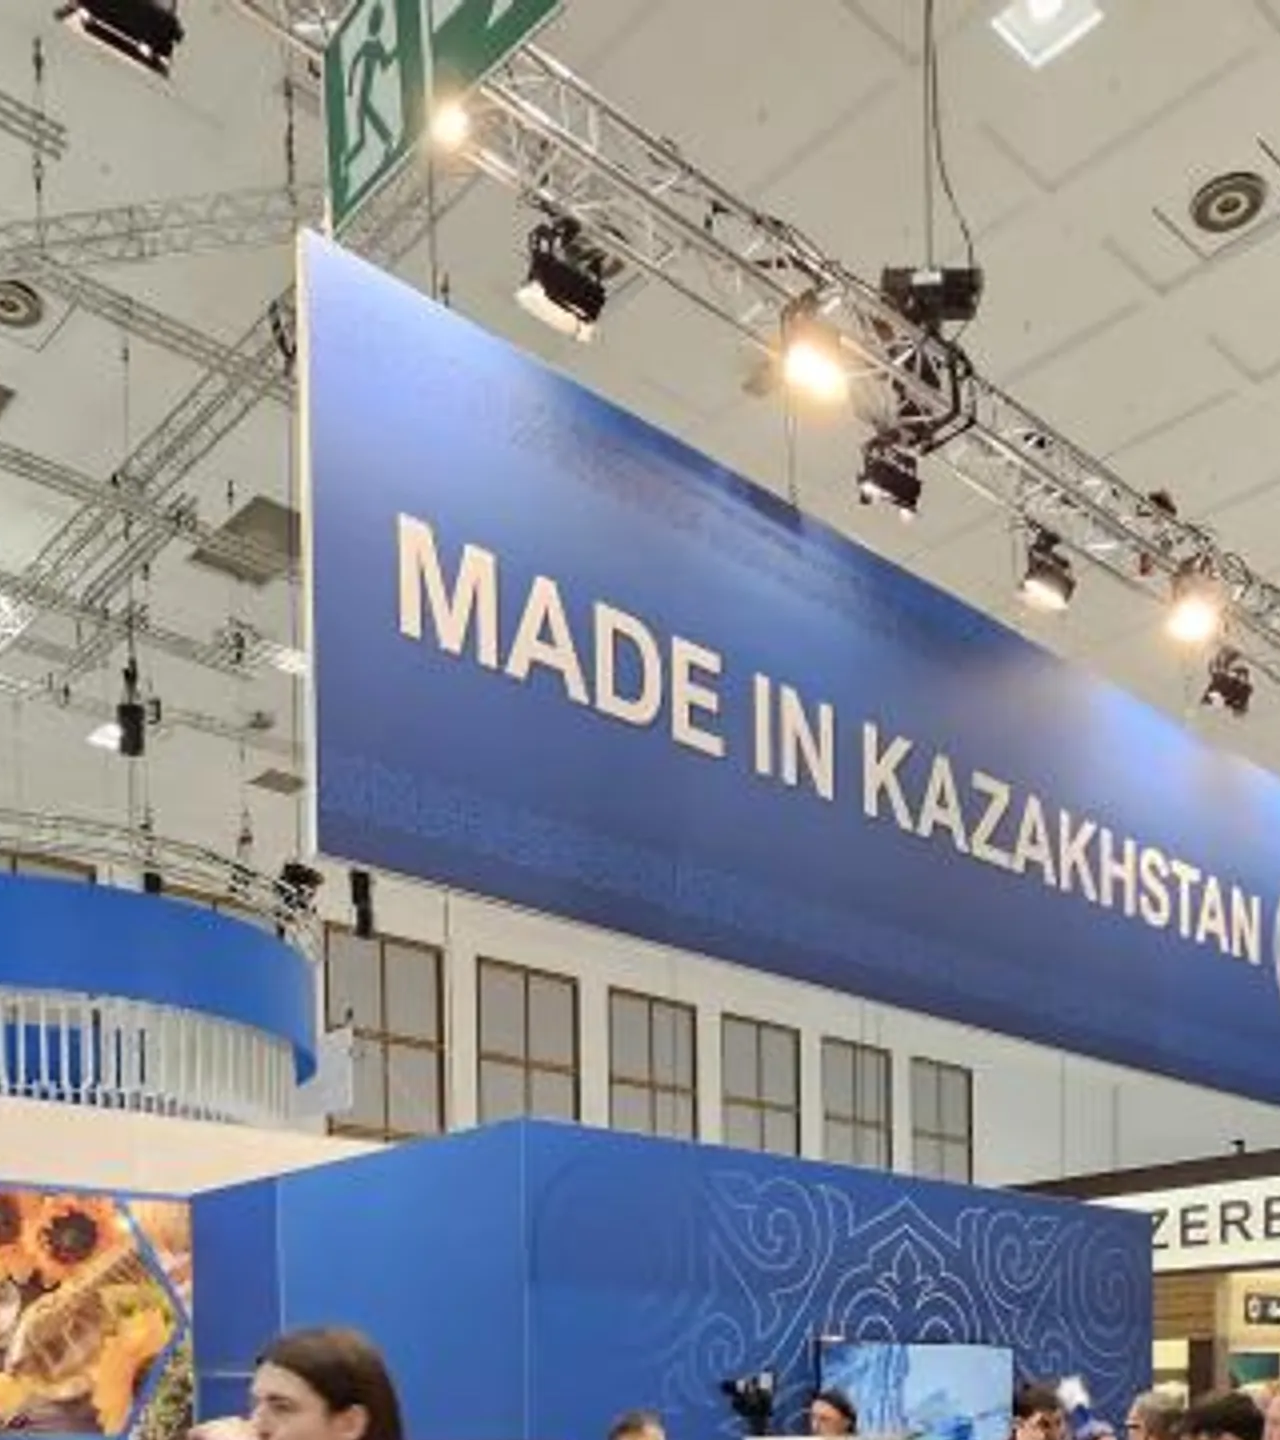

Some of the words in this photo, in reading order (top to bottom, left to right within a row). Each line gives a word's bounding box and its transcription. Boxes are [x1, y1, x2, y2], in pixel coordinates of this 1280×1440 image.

[396, 512, 726, 758] MADE
[753, 672, 836, 801] IN
[861, 720, 1264, 967] KAZAKHSTAN
